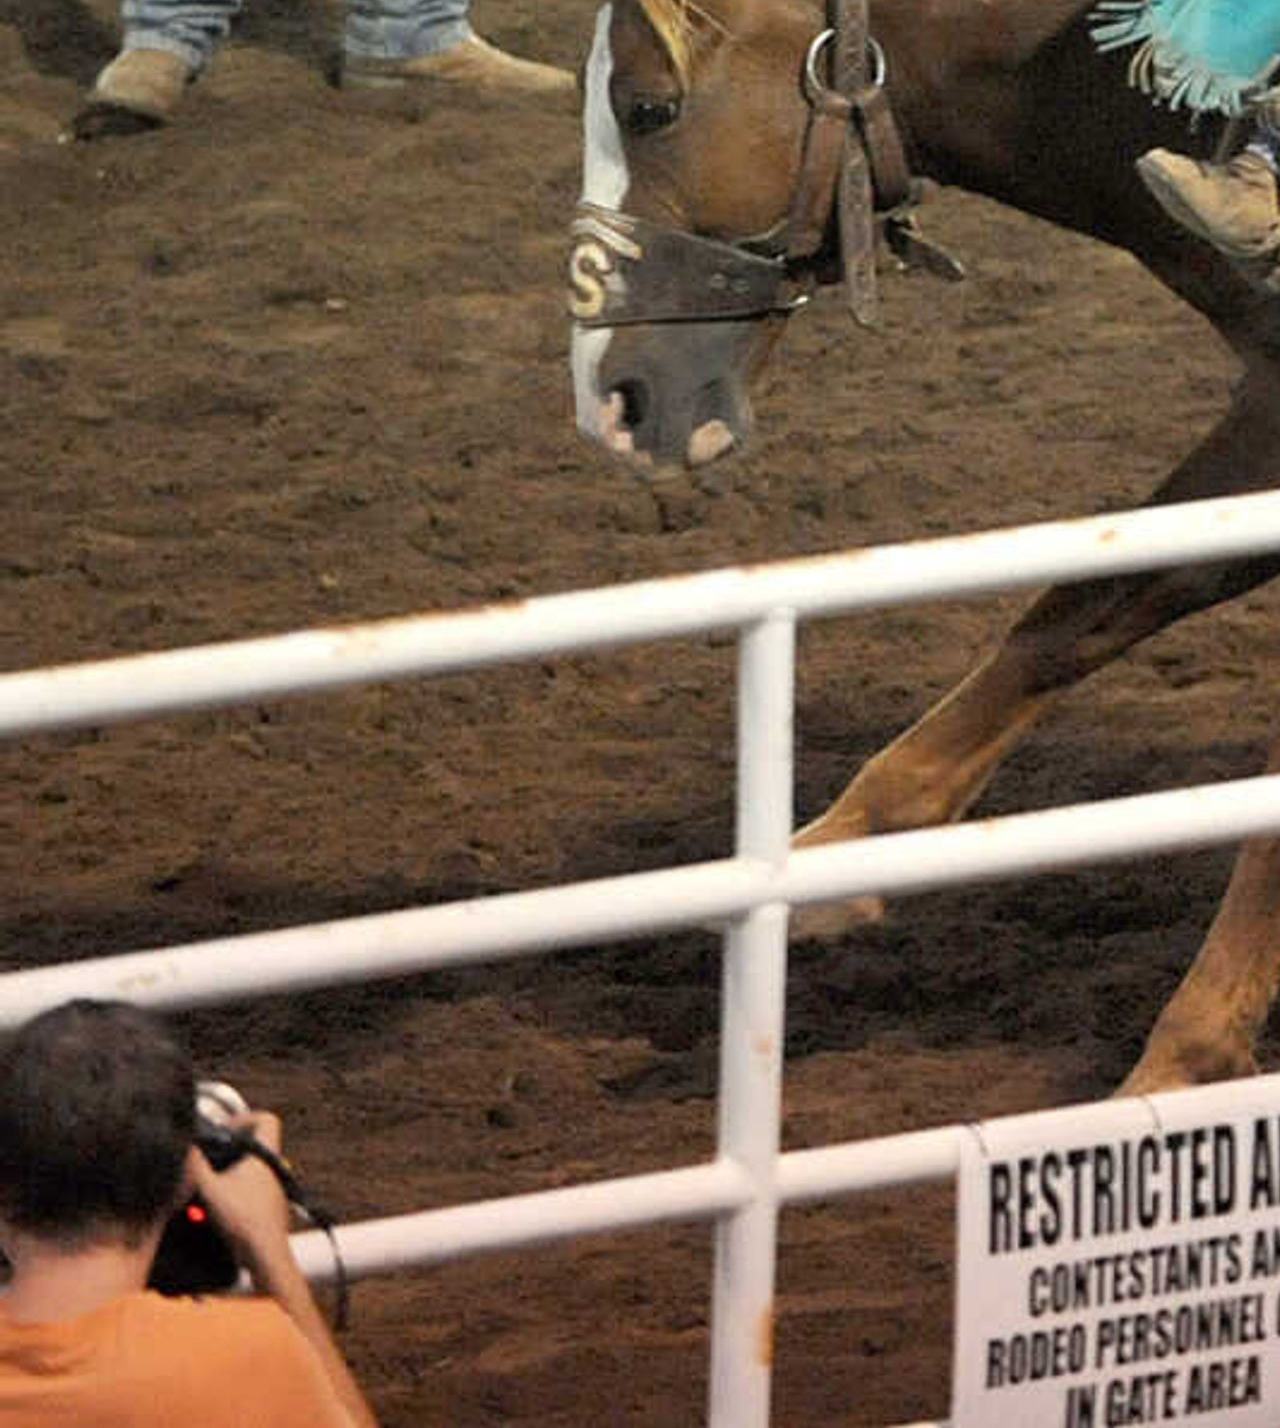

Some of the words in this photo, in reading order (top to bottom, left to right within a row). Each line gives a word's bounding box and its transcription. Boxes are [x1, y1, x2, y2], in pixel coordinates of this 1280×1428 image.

[988, 1123, 1237, 1255] RESTRICTED
[1028, 1234, 1242, 1319] CONTESTANTS
[985, 1323, 1087, 1389] RODEO
[1098, 1294, 1267, 1370] PERSONNEL
[1065, 1384, 1097, 1428] IN
[1105, 1369, 1180, 1428] GATE
[1184, 1355, 1262, 1413] AREA
